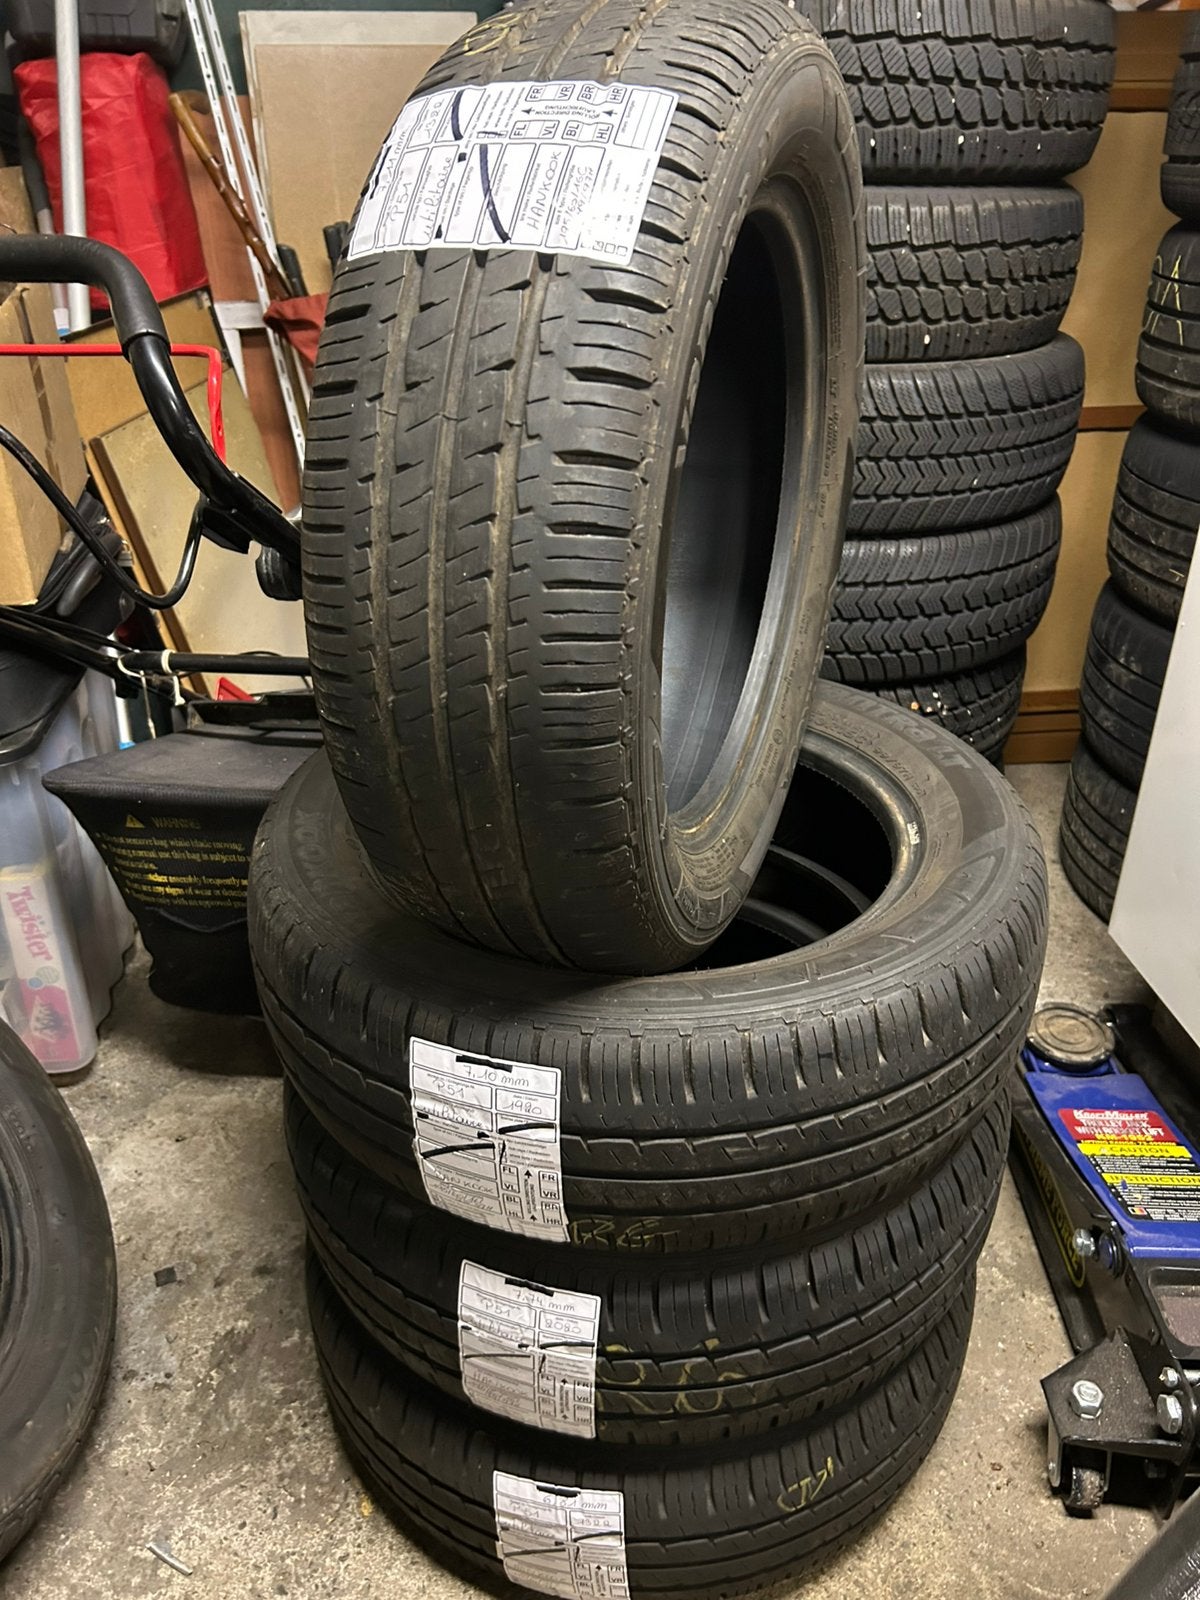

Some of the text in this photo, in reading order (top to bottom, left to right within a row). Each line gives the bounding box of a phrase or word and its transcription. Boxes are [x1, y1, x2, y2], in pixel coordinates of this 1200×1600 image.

[529, 87, 541, 100] FR
[557, 86, 572, 100] VR
[581, 85, 595, 99] BR
[612, 87, 624, 101] HR
[514, 122, 527, 136] FL
[541, 122, 556, 136] VL
[566, 123, 580, 133] BL
[596, 126, 611, 139] HL
[526, 151, 561, 230] HANKOOK
[7, 885, 53, 961] Twister
[501, 1074, 530, 1088] mm
[1080, 1119, 1122, 1128] TROLLEY
[1074, 1126, 1101, 1135] WITH
[1141, 1127, 1165, 1137] LIFT
[1109, 1145, 1170, 1154] CAUTION
[502, 1166, 515, 1175] FL
[542, 1173, 556, 1182] FR
[504, 1183, 517, 1191] VL
[543, 1190, 557, 1198] VR
[548, 1301, 575, 1312] mm
